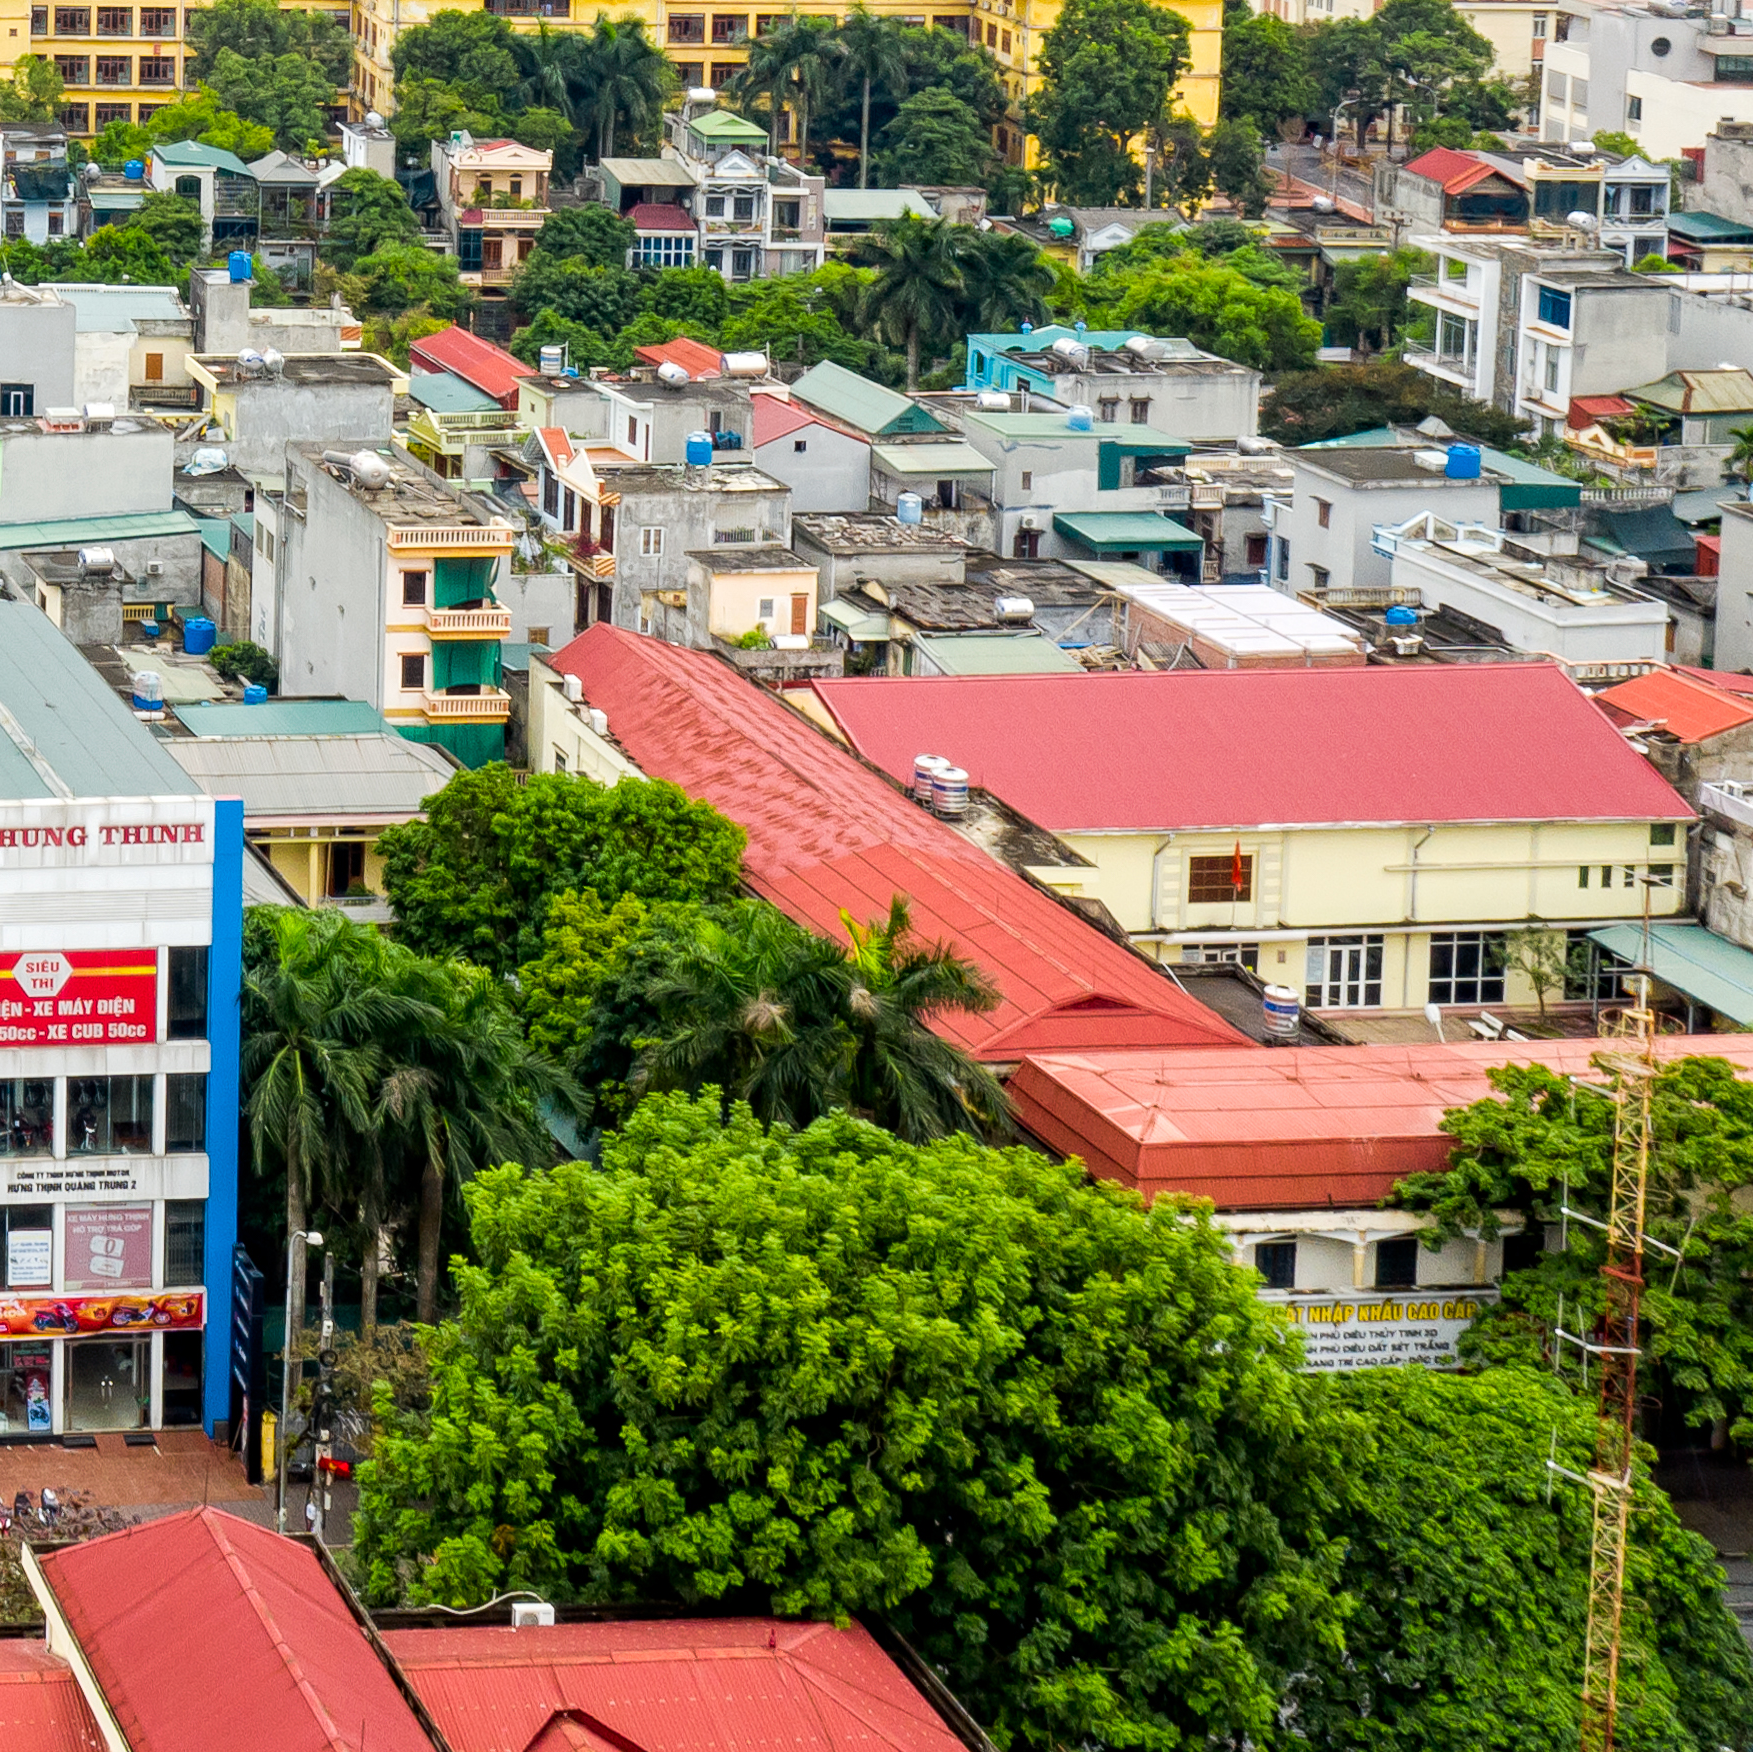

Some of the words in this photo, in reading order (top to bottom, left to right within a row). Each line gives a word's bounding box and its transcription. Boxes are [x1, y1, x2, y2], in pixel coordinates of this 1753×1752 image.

[99, 823, 205, 845] THINH
[25, 959, 60, 974] SIÊU
[30, 978, 54, 992] THỊ
[33, 1000, 53, 1016] XE
[58, 997, 93, 1015] MÁY
[97, 996, 135, 1017] ĐIỆN
[47, 1024, 67, 1040] XE
[71, 1022, 103, 1040] CUB
[108, 1022, 147, 1038] 50cc
[36, 1171, 44, 1179] TY
[98, 1180, 129, 1191] TRUNG
[131, 1180, 137, 1189] 2
[1308, 1301, 1355, 1327] NHẬP
[1358, 1299, 1404, 1321] KHẨU
[1406, 1301, 1440, 1321] CAO
